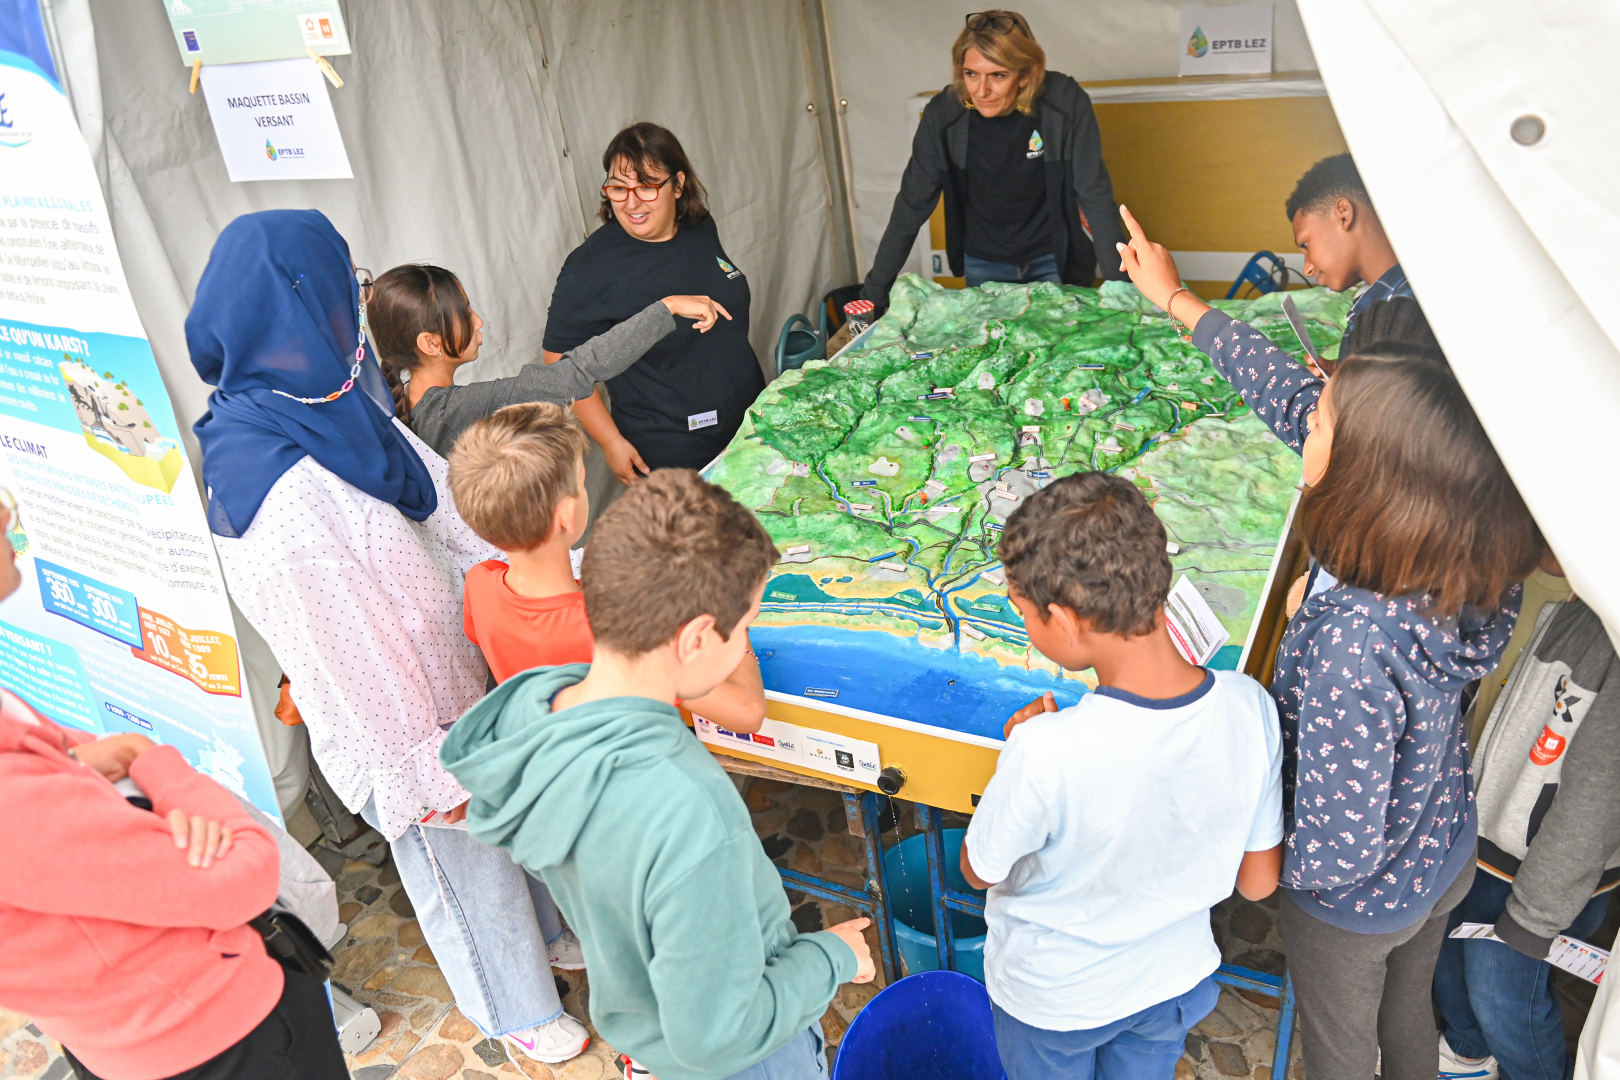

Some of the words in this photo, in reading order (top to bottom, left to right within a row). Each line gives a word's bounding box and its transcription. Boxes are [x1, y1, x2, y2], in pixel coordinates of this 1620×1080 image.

[1212, 40, 1242, 50] EPTB
[1245, 38, 1267, 48] LEZ
[227, 94, 278, 109] MAQUETTE
[277, 92, 311, 105] BASSIN
[254, 115, 295, 128] VERSANT
[277, 148, 293, 156] EPTB
[10, 327, 46, 348] QU'UN
[44, 333, 83, 354] KARST
[0, 434, 13, 449] LE
[12, 437, 49, 459] CLIMAT
[168, 547, 210, 562] automne
[46, 577, 75, 605] 360
[87, 593, 118, 623] 300
[147, 631, 169, 659] 10
[190, 635, 222, 645] JUILLET,
[192, 644, 212, 653] 1989
